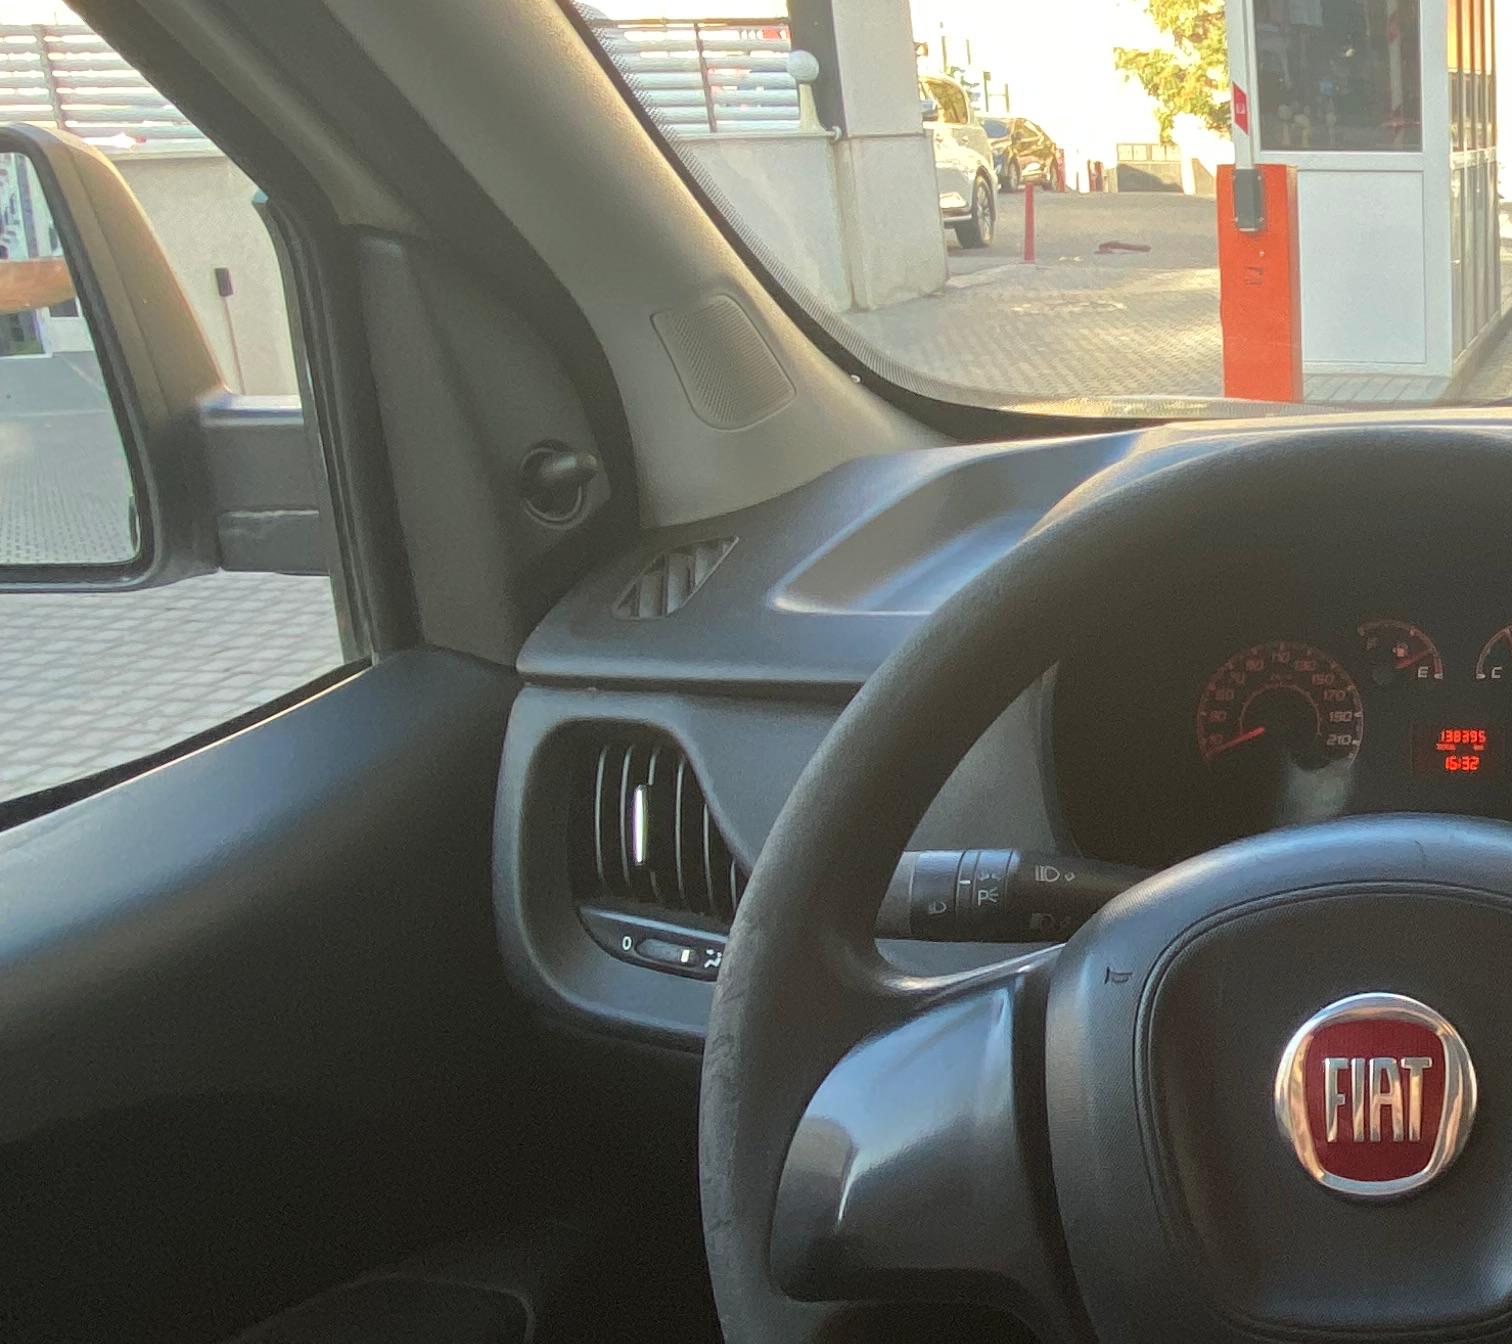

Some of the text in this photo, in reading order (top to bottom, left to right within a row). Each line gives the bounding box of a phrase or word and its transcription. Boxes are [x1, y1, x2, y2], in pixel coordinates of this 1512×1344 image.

[1417, 666, 1429, 678] E
[1491, 666, 1503, 679] C
[1326, 734, 1353, 746] 210
[1322, 1056, 1433, 1143] FIAT
